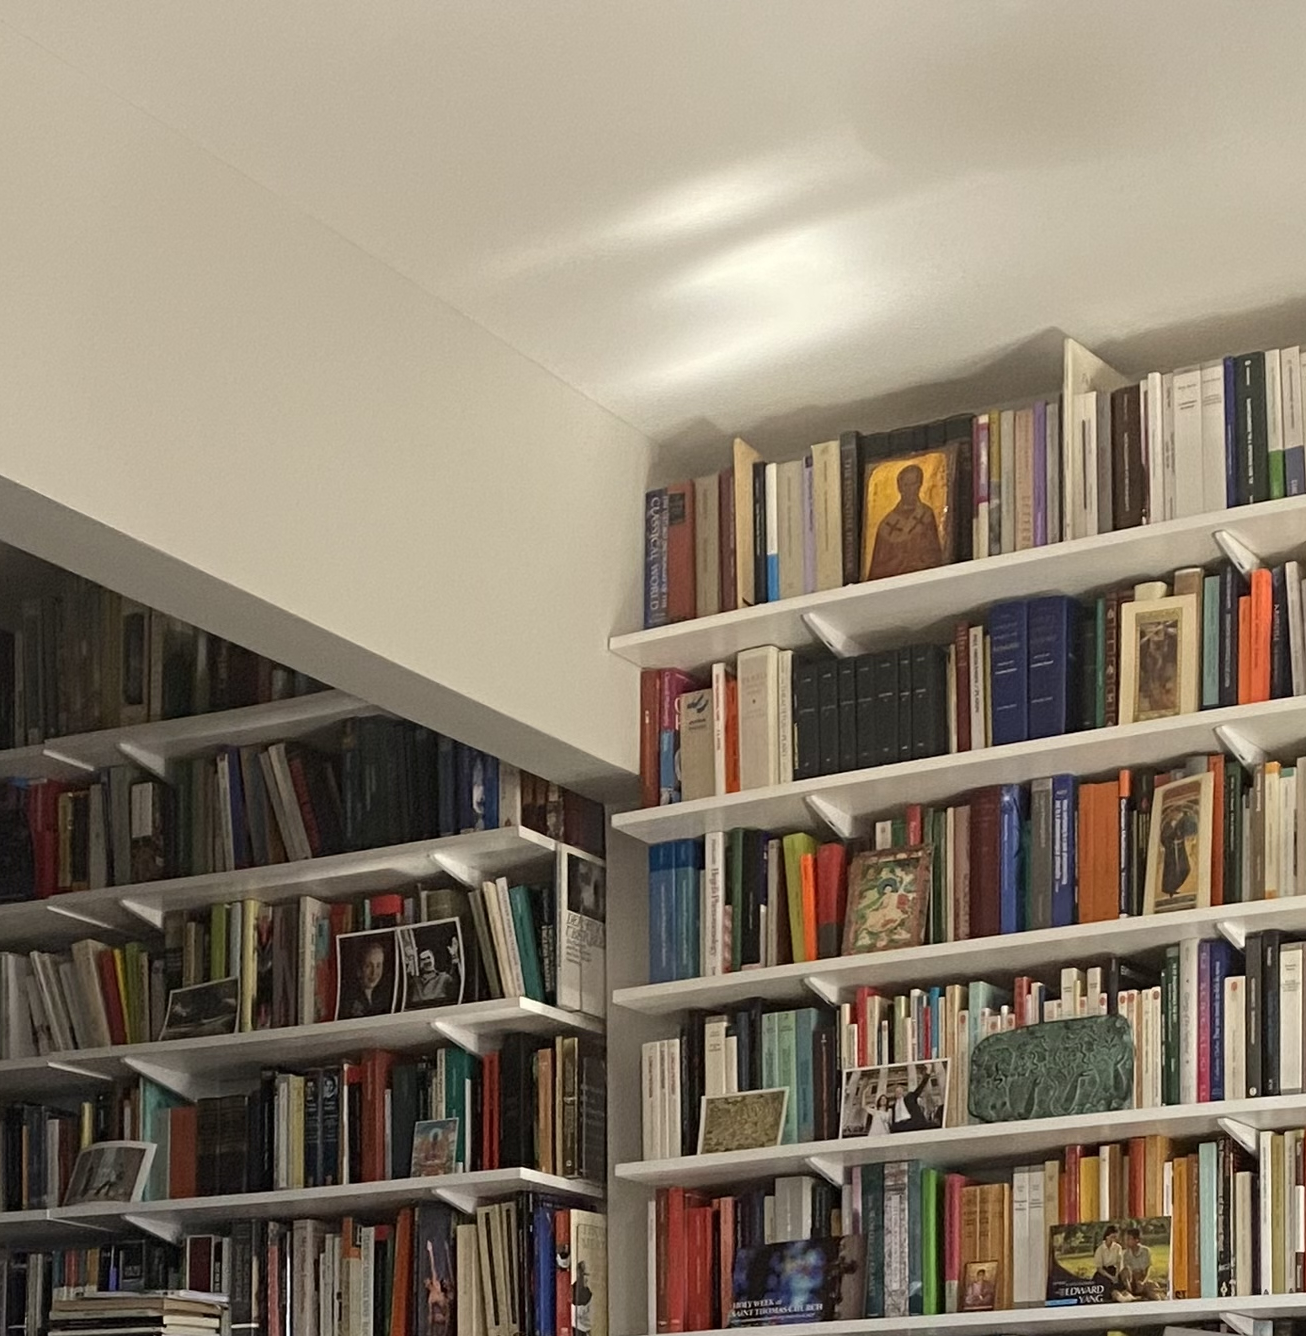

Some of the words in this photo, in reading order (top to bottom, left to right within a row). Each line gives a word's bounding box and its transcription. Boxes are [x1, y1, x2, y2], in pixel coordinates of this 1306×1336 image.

[650, 497, 661, 560] CLASSICAL
[650, 565, 660, 610] WORLD
[1065, 1285, 1104, 1296] EDWARD
[1079, 1294, 1104, 1303] YANG
[788, 1303, 823, 1313] CHURCH
